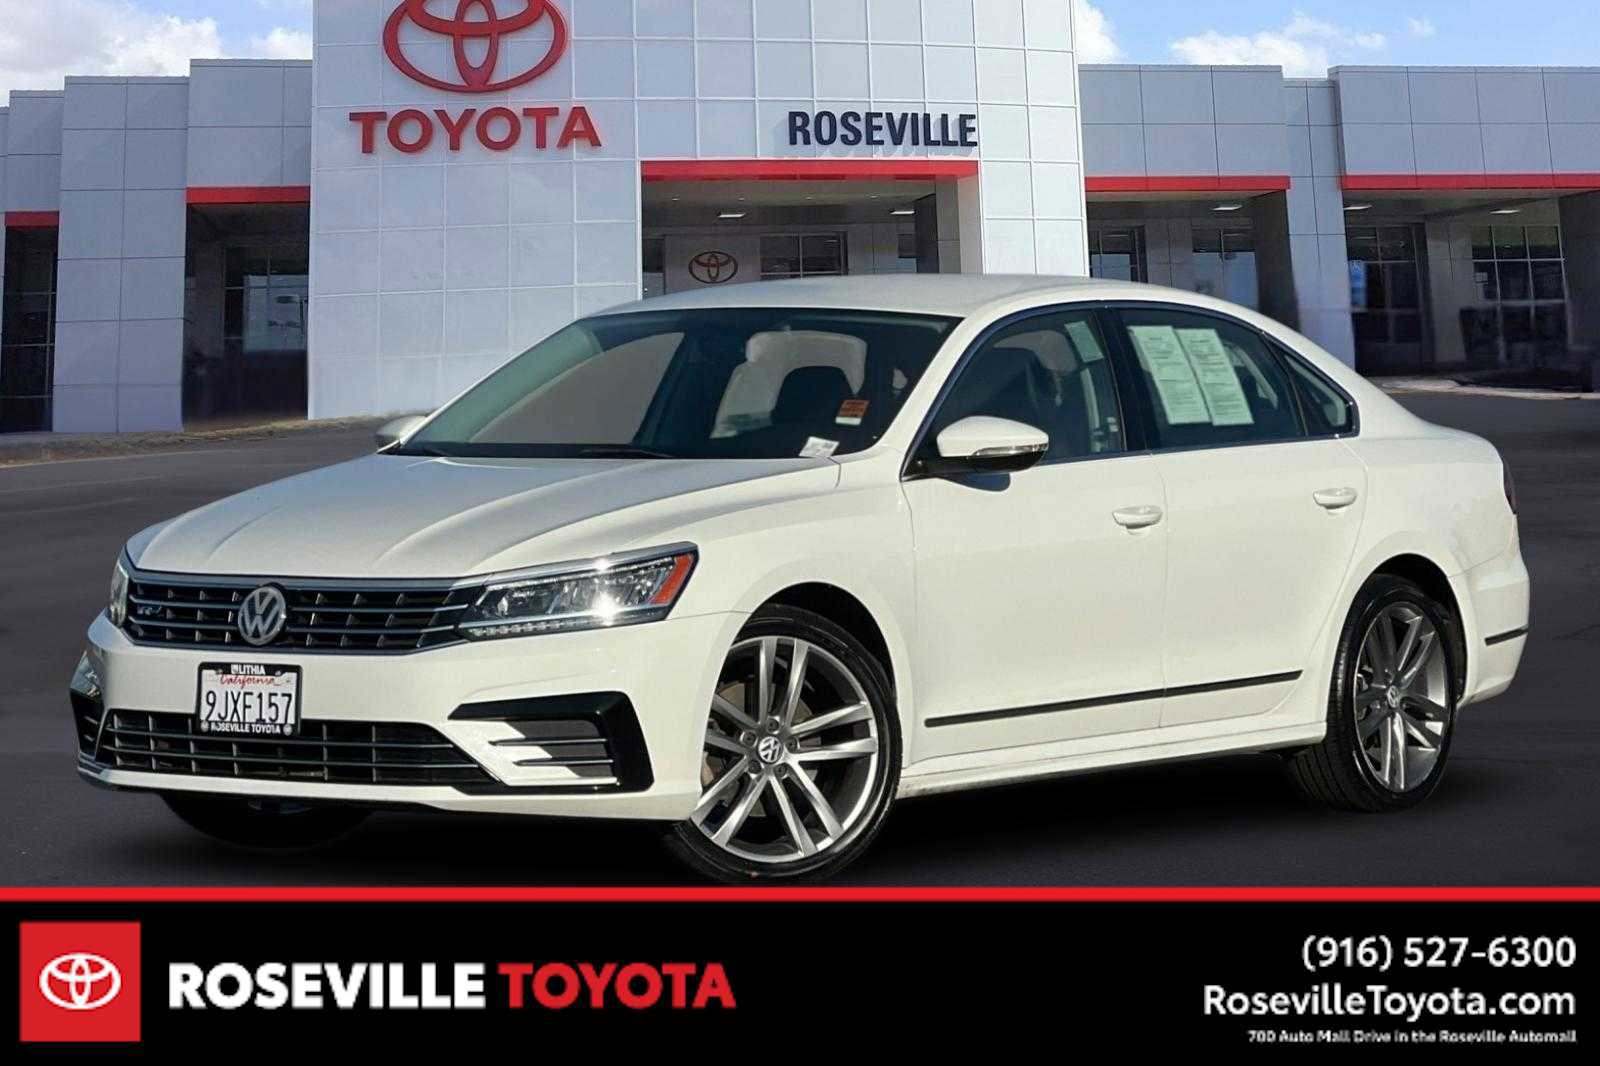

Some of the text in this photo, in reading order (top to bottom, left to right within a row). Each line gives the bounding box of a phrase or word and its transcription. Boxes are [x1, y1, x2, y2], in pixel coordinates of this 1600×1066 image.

[349, 106, 602, 153] TOYOTA
[788, 111, 978, 147] ROSEVILLE
[238, 664, 266, 675] LITHIA
[205, 690, 292, 724] 9JXF157
[210, 722, 281, 734] ROSEVILLE TOYOTA
